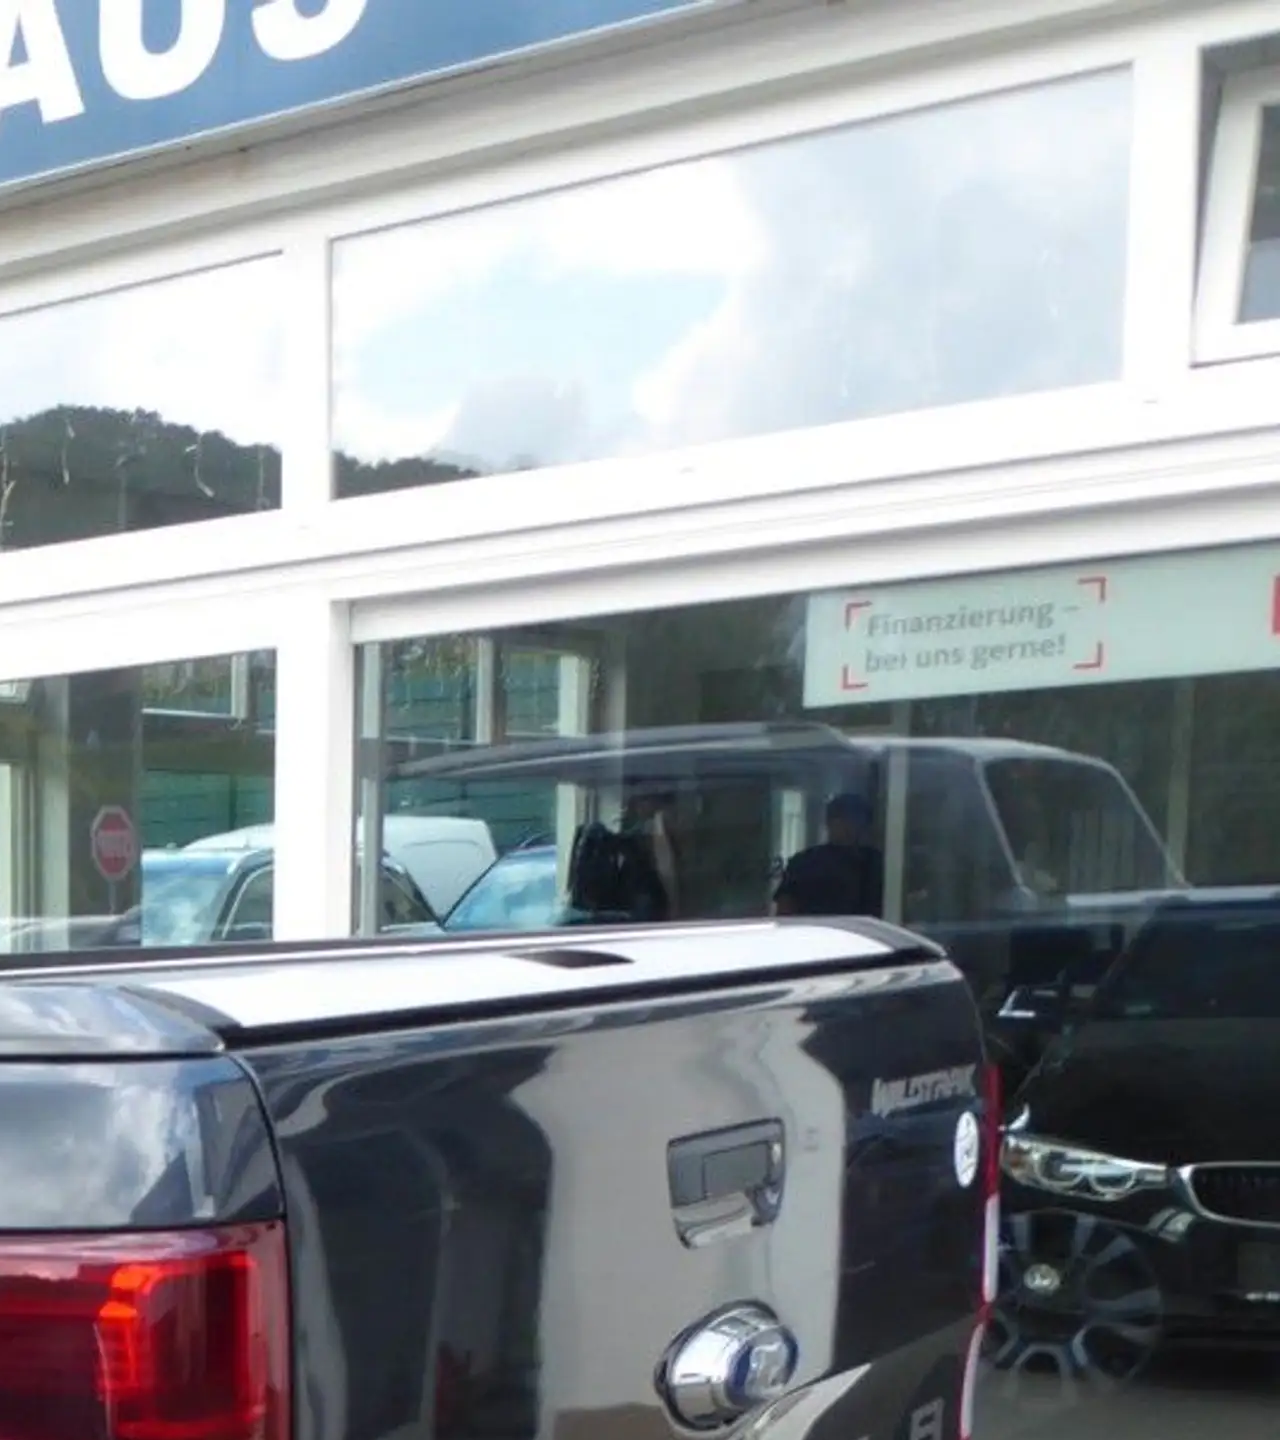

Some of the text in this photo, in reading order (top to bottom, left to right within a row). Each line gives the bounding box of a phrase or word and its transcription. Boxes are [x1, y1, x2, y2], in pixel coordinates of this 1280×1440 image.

[867, 602, 1056, 637] Finanzierung
[865, 633, 1067, 673] bei uns gerne!
